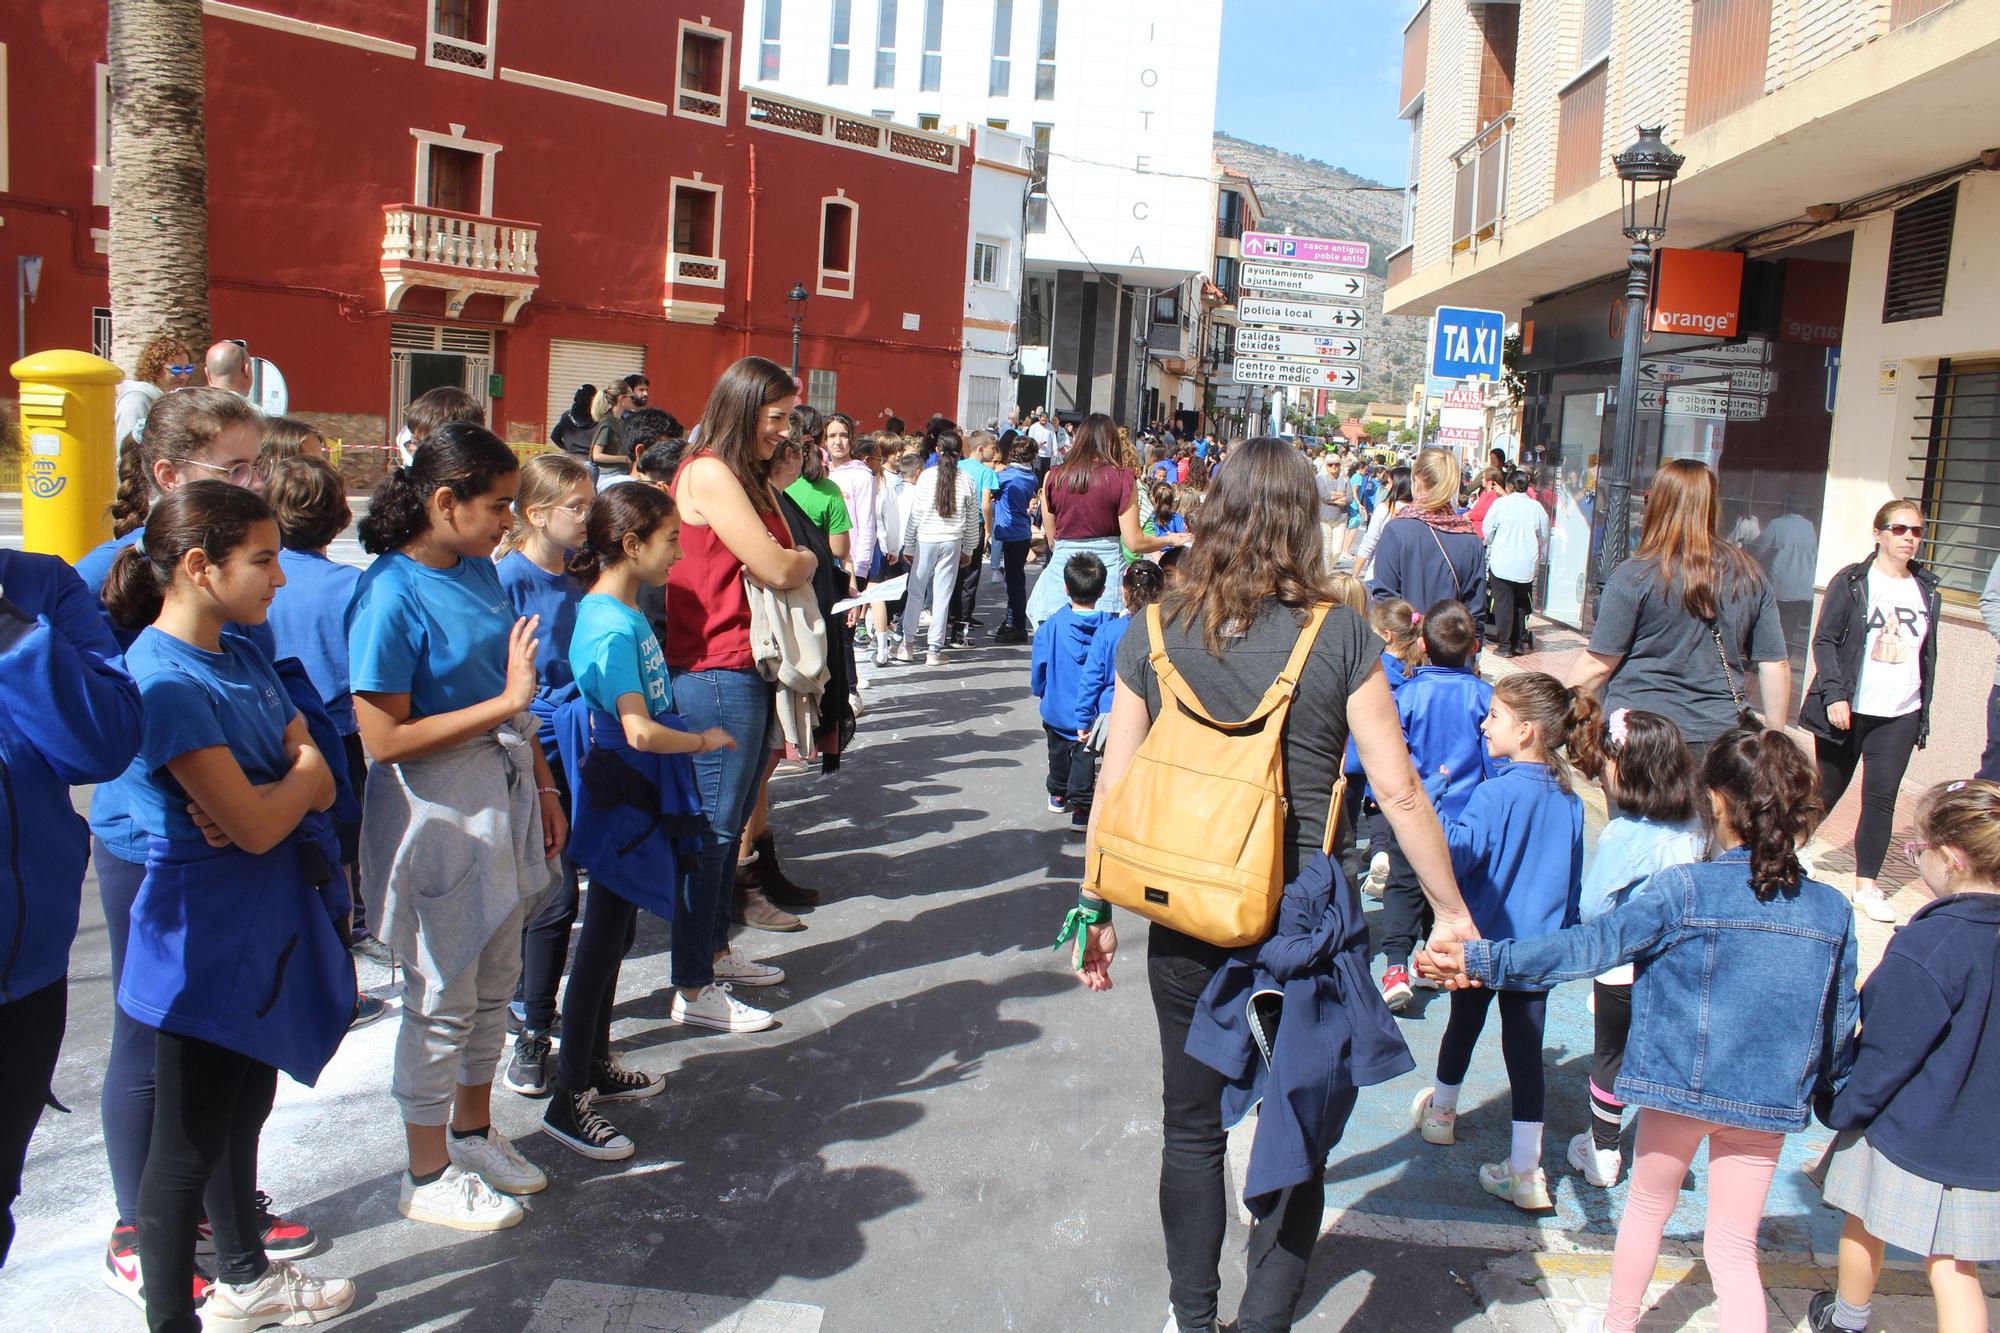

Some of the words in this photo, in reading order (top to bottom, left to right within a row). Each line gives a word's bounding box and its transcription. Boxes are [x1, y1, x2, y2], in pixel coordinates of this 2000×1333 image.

[1303, 242, 1329, 251] casco
[1332, 245, 1365, 255] antiguo
[1314, 252, 1340, 261] poble
[1247, 267, 1314, 280] ayuntamiento
[1246, 276, 1302, 289] ajuntament
[1285, 308, 1313, 318] local
[1659, 311, 1728, 332] orange
[1240, 332, 1281, 342] salidas
[1314, 338, 1333, 346] AP-7
[1240, 341, 1280, 351] eixides
[1443, 324, 1497, 365] TAXI
[1315, 347, 1341, 356] N-340
[1239, 362, 1275, 372] centro
[1238, 371, 1275, 380] centre
[1446, 390, 1480, 404] TAXIS
[1440, 427, 1467, 438] TAXI
